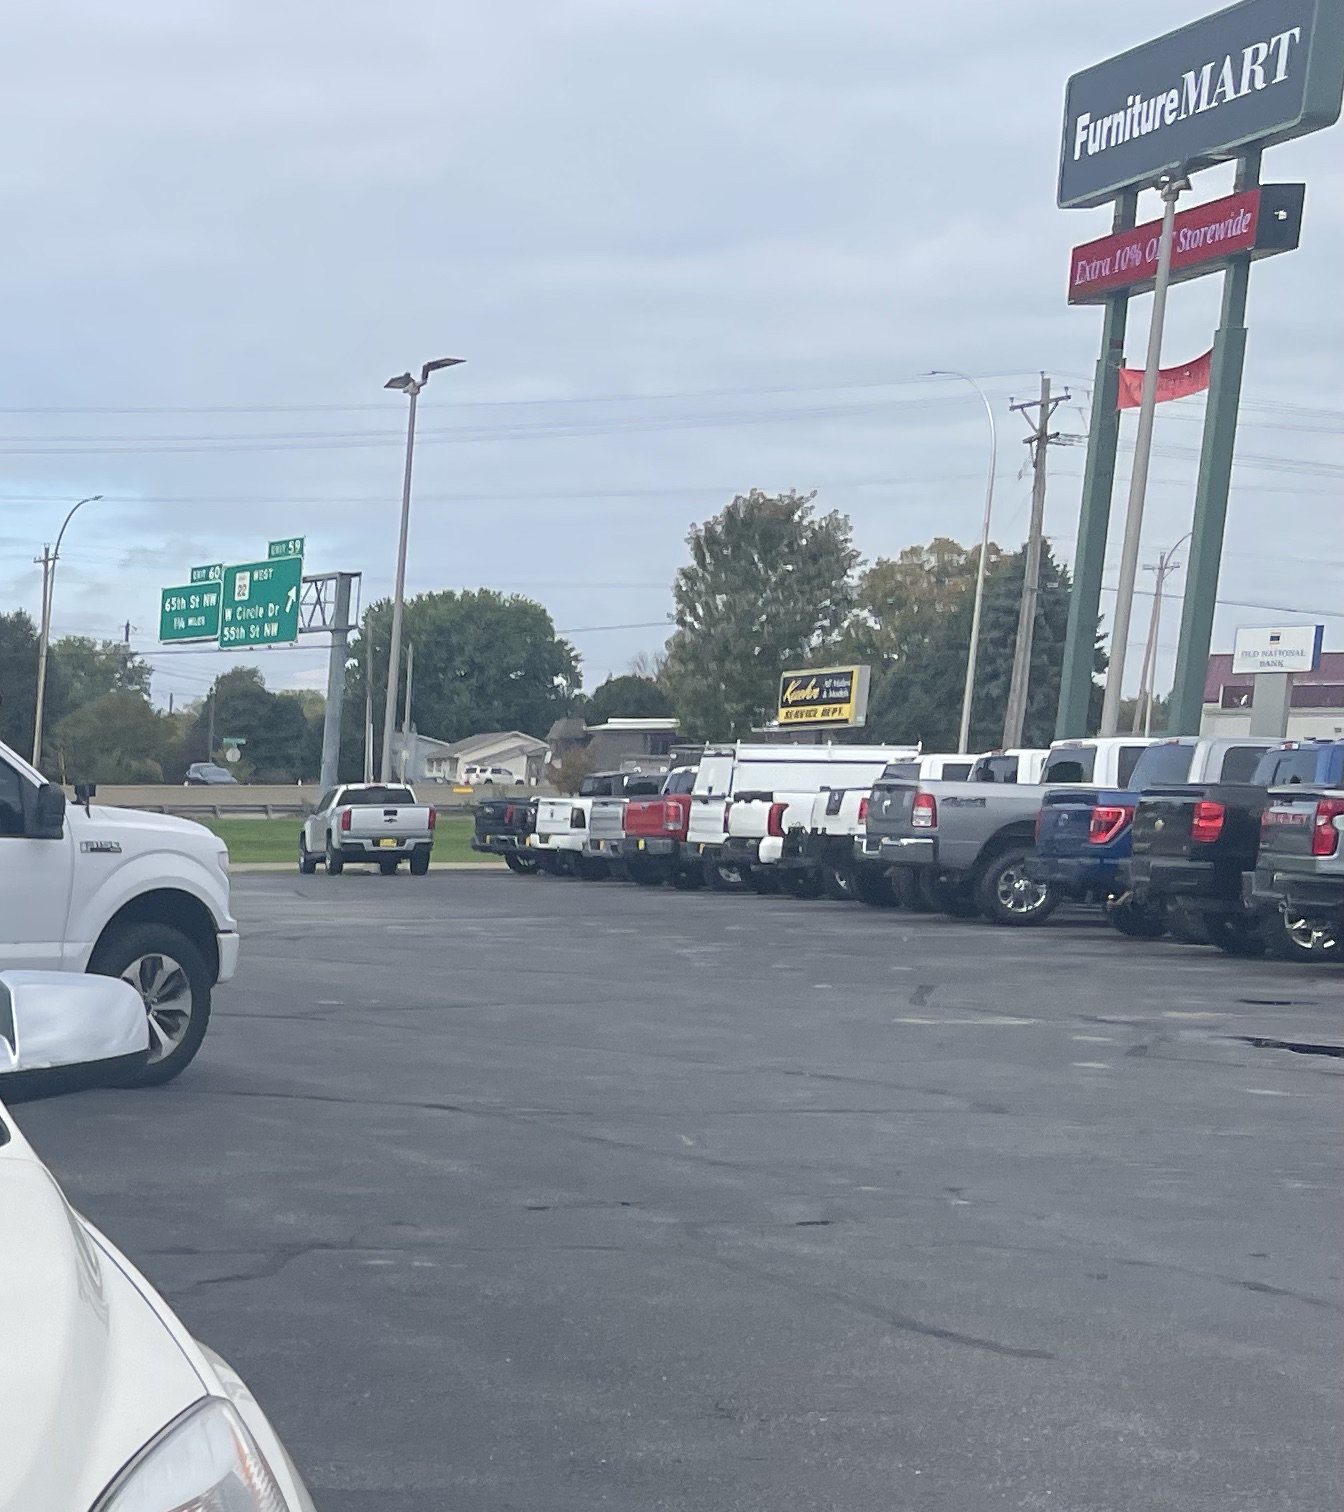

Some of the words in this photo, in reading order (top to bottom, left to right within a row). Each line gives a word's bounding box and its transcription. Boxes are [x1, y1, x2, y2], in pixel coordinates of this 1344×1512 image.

[1073, 26, 1301, 161] FurnitureMART
[1074, 255, 1113, 286] Extra
[1112, 242, 1142, 273] 10%
[1176, 208, 1253, 254] Storewide
[288, 539, 301, 555] 59
[208, 565, 221, 580] 60
[253, 568, 273, 582] WEST
[236, 583, 247, 598] 22
[164, 596, 187, 612] 65th
[189, 594, 200, 609] St
[203, 592, 217, 607] NW
[224, 608, 233, 622] W
[236, 604, 264, 621] Circle
[268, 602, 280, 618] Dr
[223, 625, 246, 641] 55th
[249, 624, 260, 639] St
[263, 622, 279, 638] NW
[1261, 648, 1307, 658] NATIONAL
[1259, 659, 1285, 668] BANK
[784, 707, 818, 720] SERVICE
